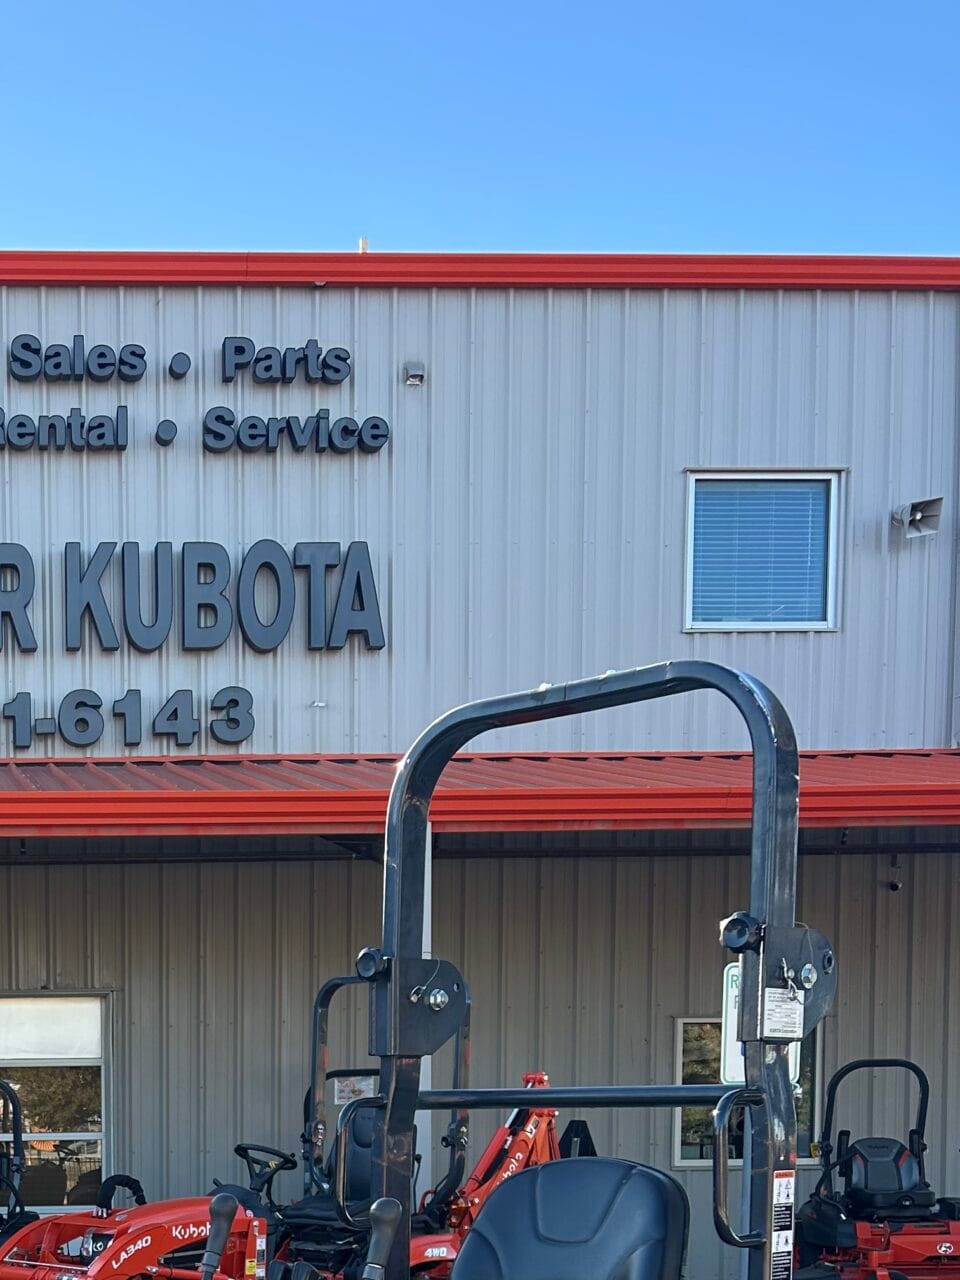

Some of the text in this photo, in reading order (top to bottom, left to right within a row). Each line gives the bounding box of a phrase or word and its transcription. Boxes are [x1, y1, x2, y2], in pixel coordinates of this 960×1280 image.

[9, 334, 352, 385] Sales Parts
[203, 406, 390, 455] Service
[64, 538, 386, 654] KUBOTA
[172, 1222, 211, 1239] Kubot
[112, 1236, 152, 1269] LA340
[424, 1247, 447, 1257] 4WD
